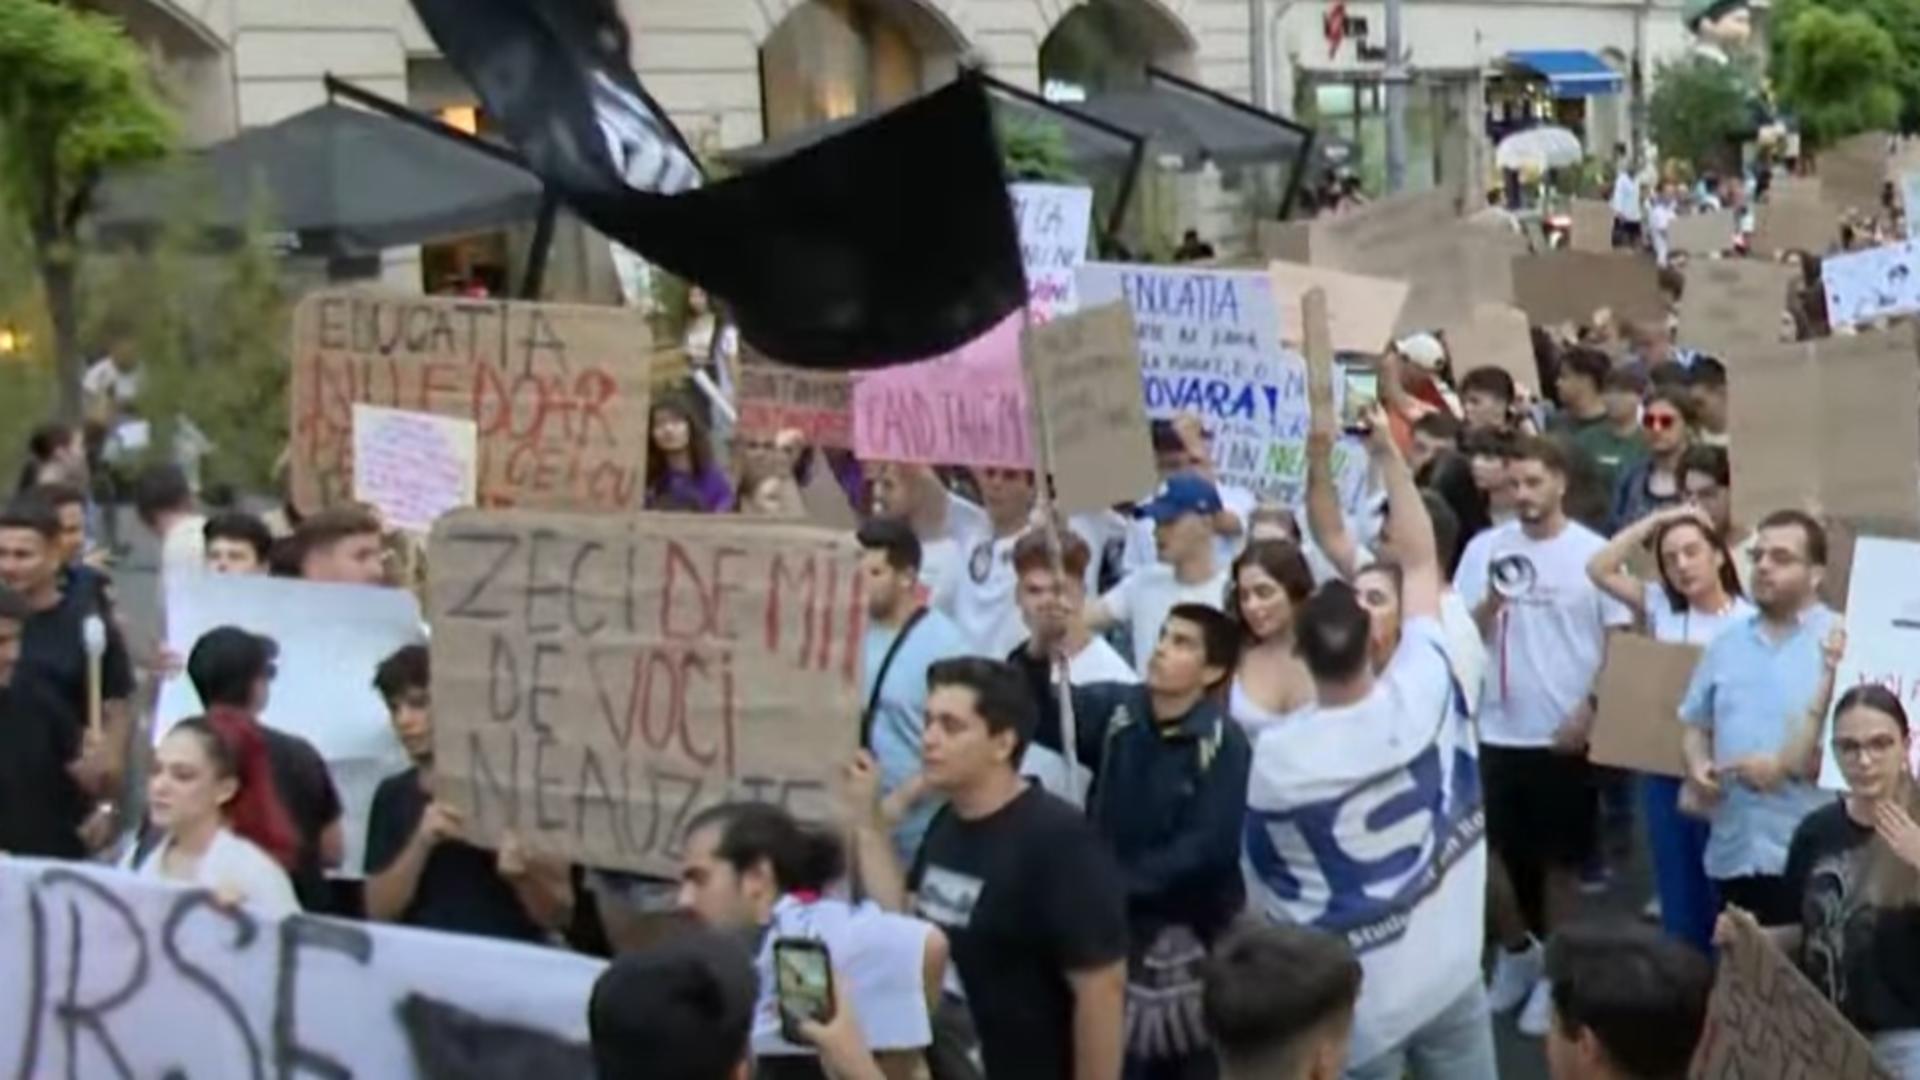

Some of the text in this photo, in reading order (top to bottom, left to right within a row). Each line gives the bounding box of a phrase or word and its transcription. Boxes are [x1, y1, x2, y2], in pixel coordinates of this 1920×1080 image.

[472, 360, 618, 447] DOAR
[1143, 375, 1278, 427] OVARA!
[446, 523, 868, 686] ZECI DE MII
[488, 634, 736, 779] DE VOCI
[468, 731, 826, 860] NEAUZTE
